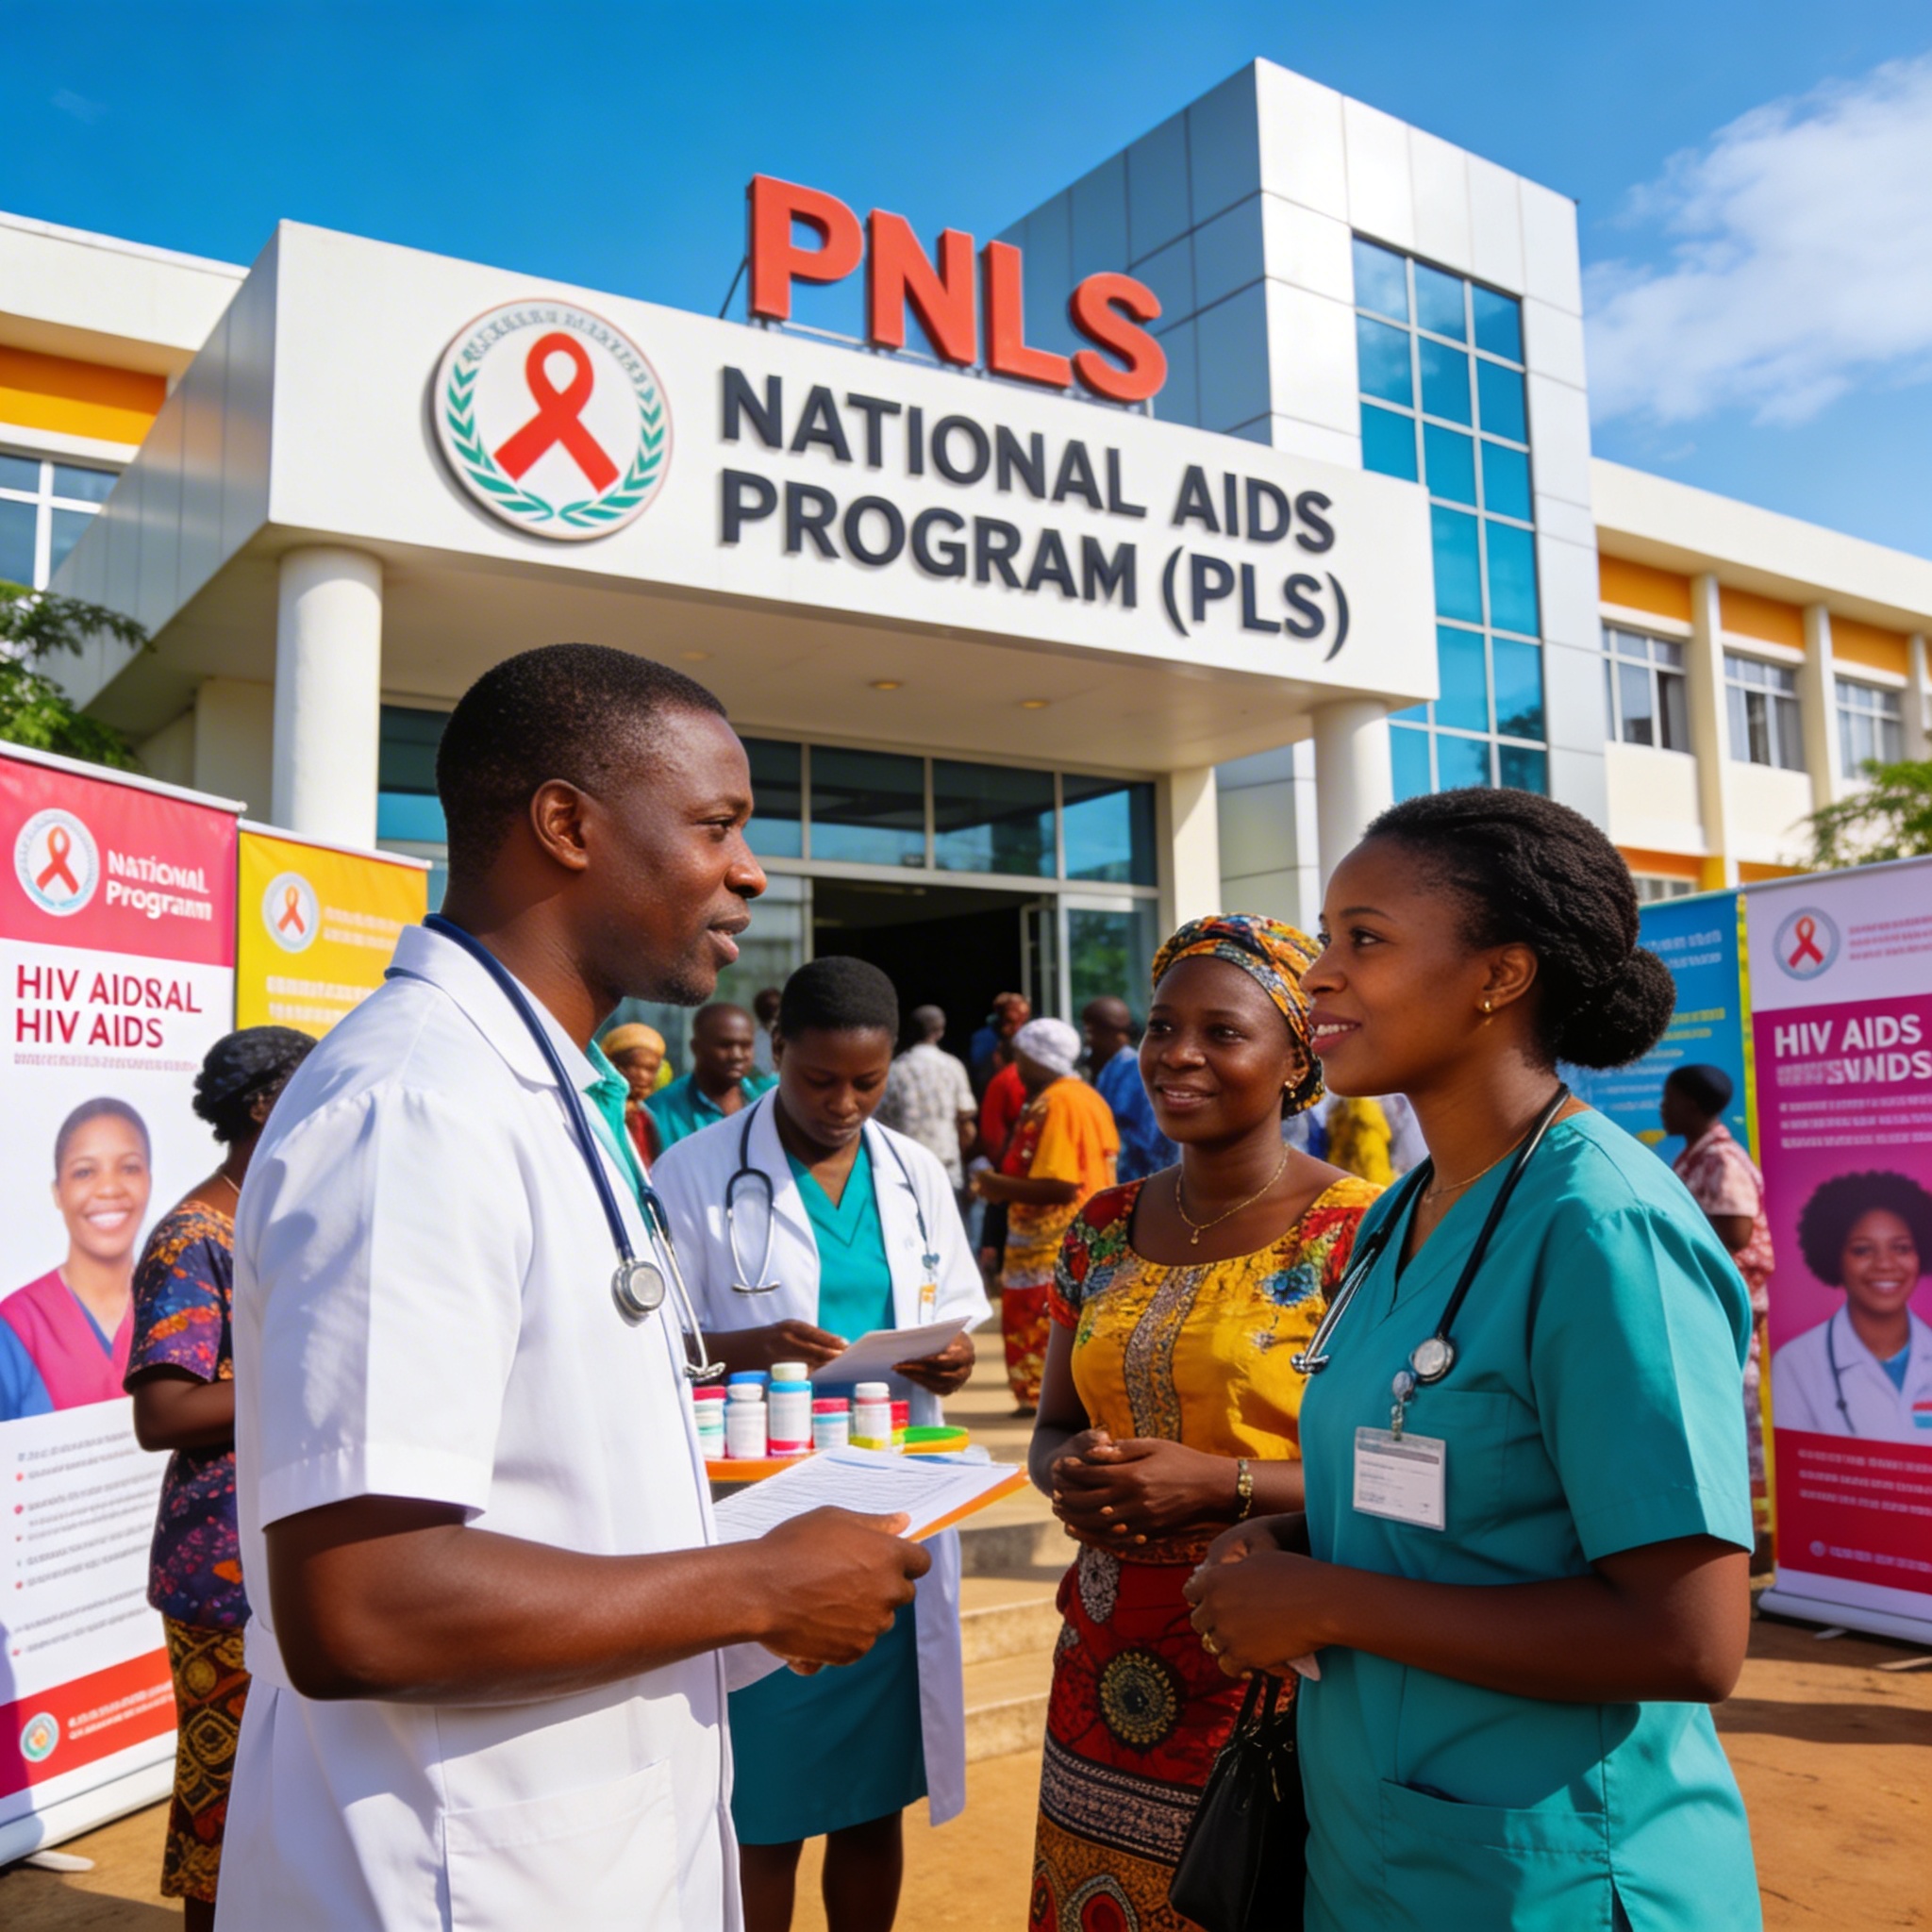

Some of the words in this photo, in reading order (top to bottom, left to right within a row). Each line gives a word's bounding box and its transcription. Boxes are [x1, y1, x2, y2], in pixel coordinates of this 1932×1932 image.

[747, 174, 1168, 402] PNLS
[722, 366, 1146, 518] NATIONAL
[1172, 465, 1335, 553] AIDS
[720, 469, 1137, 608] PROGRAM
[1163, 546, 1349, 661] (PLS)
[16, 1008, 80, 1043] HIV
[89, 1013, 163, 1048] AIDS
[17, 964, 80, 1001] HIV
[1775, 1021, 1833, 1058] HIV
[1841, 1014, 1923, 1052] AIDS
